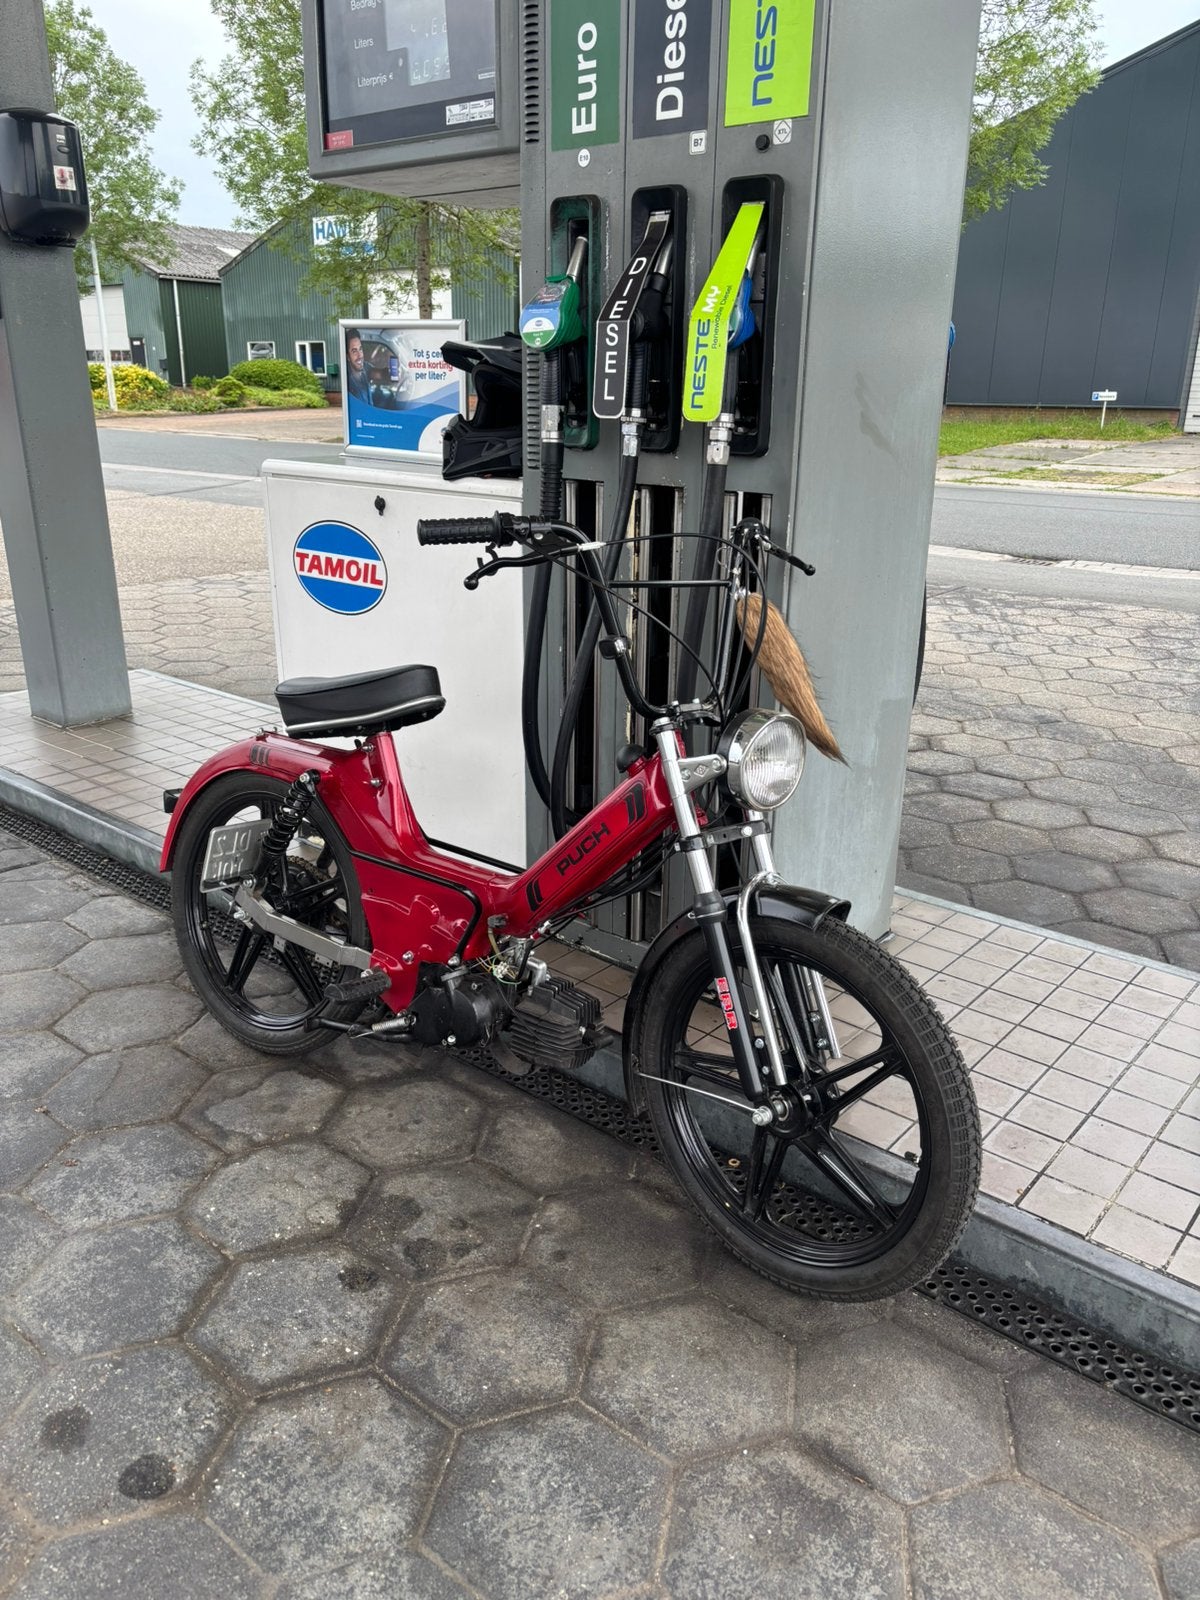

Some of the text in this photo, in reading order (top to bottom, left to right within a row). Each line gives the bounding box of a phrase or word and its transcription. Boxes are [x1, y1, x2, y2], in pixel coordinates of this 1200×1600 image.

[353, 38, 374, 49] Liters
[751, 0, 778, 106] NES
[357, 73, 387, 88] Literprijs
[571, 21, 597, 134] Euro
[777, 127, 788, 135] XTL
[693, 138, 704, 147] B7
[579, 154, 589, 162] E10
[711, 285, 732, 350] Renewable Diesel
[603, 257, 647, 400] DIESEL
[413, 349, 424, 358] Tot
[690, 285, 722, 409] NESTE MY
[408, 360, 426, 369] extra
[415, 371, 447, 381] per liter?
[295, 551, 384, 586] TAMOIL
[555, 822, 612, 876] PUCH
